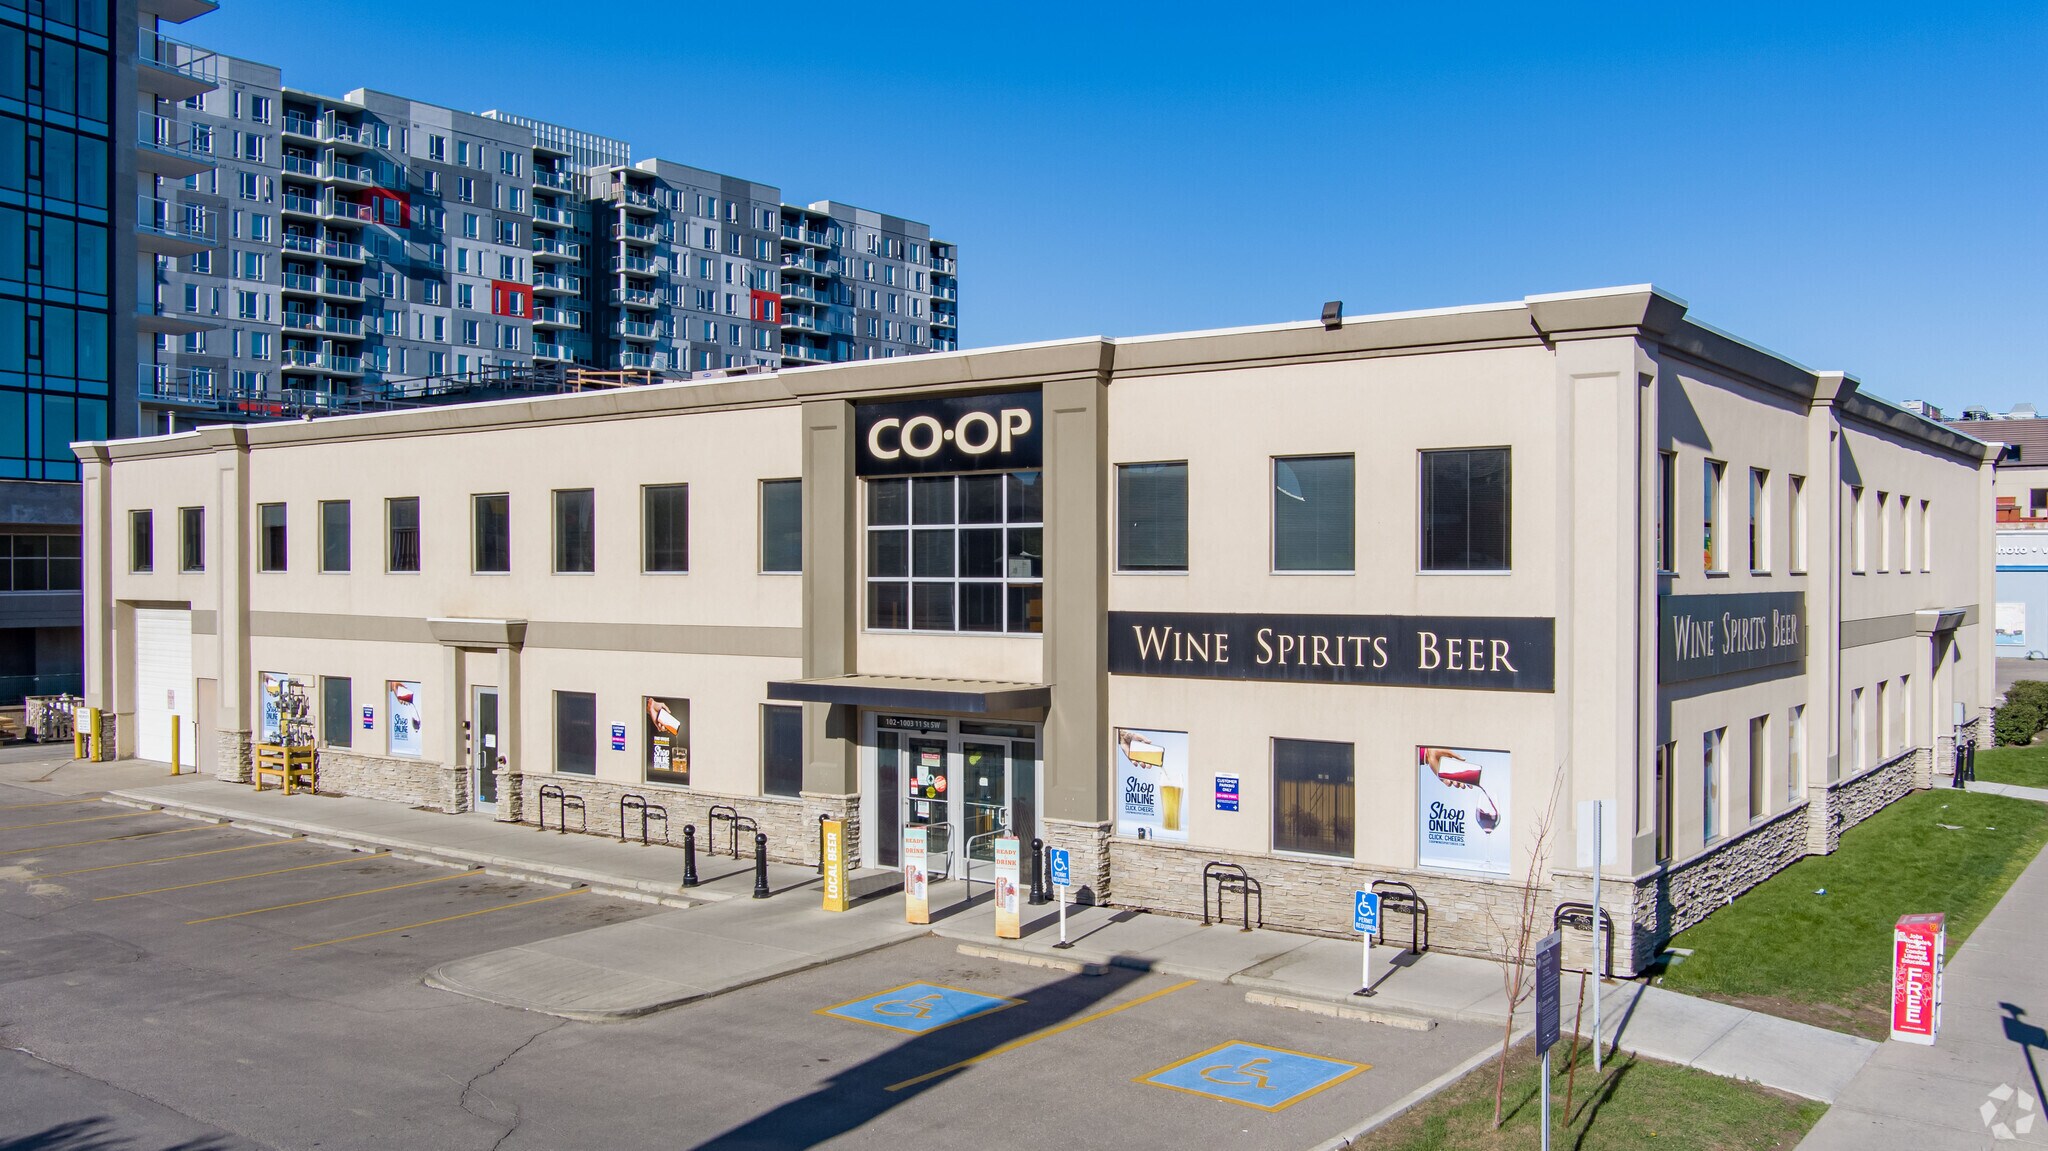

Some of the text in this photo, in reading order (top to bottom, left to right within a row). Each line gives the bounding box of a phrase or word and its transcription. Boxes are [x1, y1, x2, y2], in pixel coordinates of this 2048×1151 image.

[1996, 544, 2027, 555] hoto
[1132, 625, 1518, 673] WINE SPIRITS BEER
[886, 718, 913, 727] 102-1003
[930, 721, 941, 729] SW
[1125, 776, 1154, 797] Shop
[1125, 792, 1154, 805] ONLINE
[1429, 801, 1465, 825] Shop
[1429, 819, 1465, 833] ONLINE
[827, 832, 838, 899] LOCAL BEER
[1906, 967, 1923, 1024] FREE
